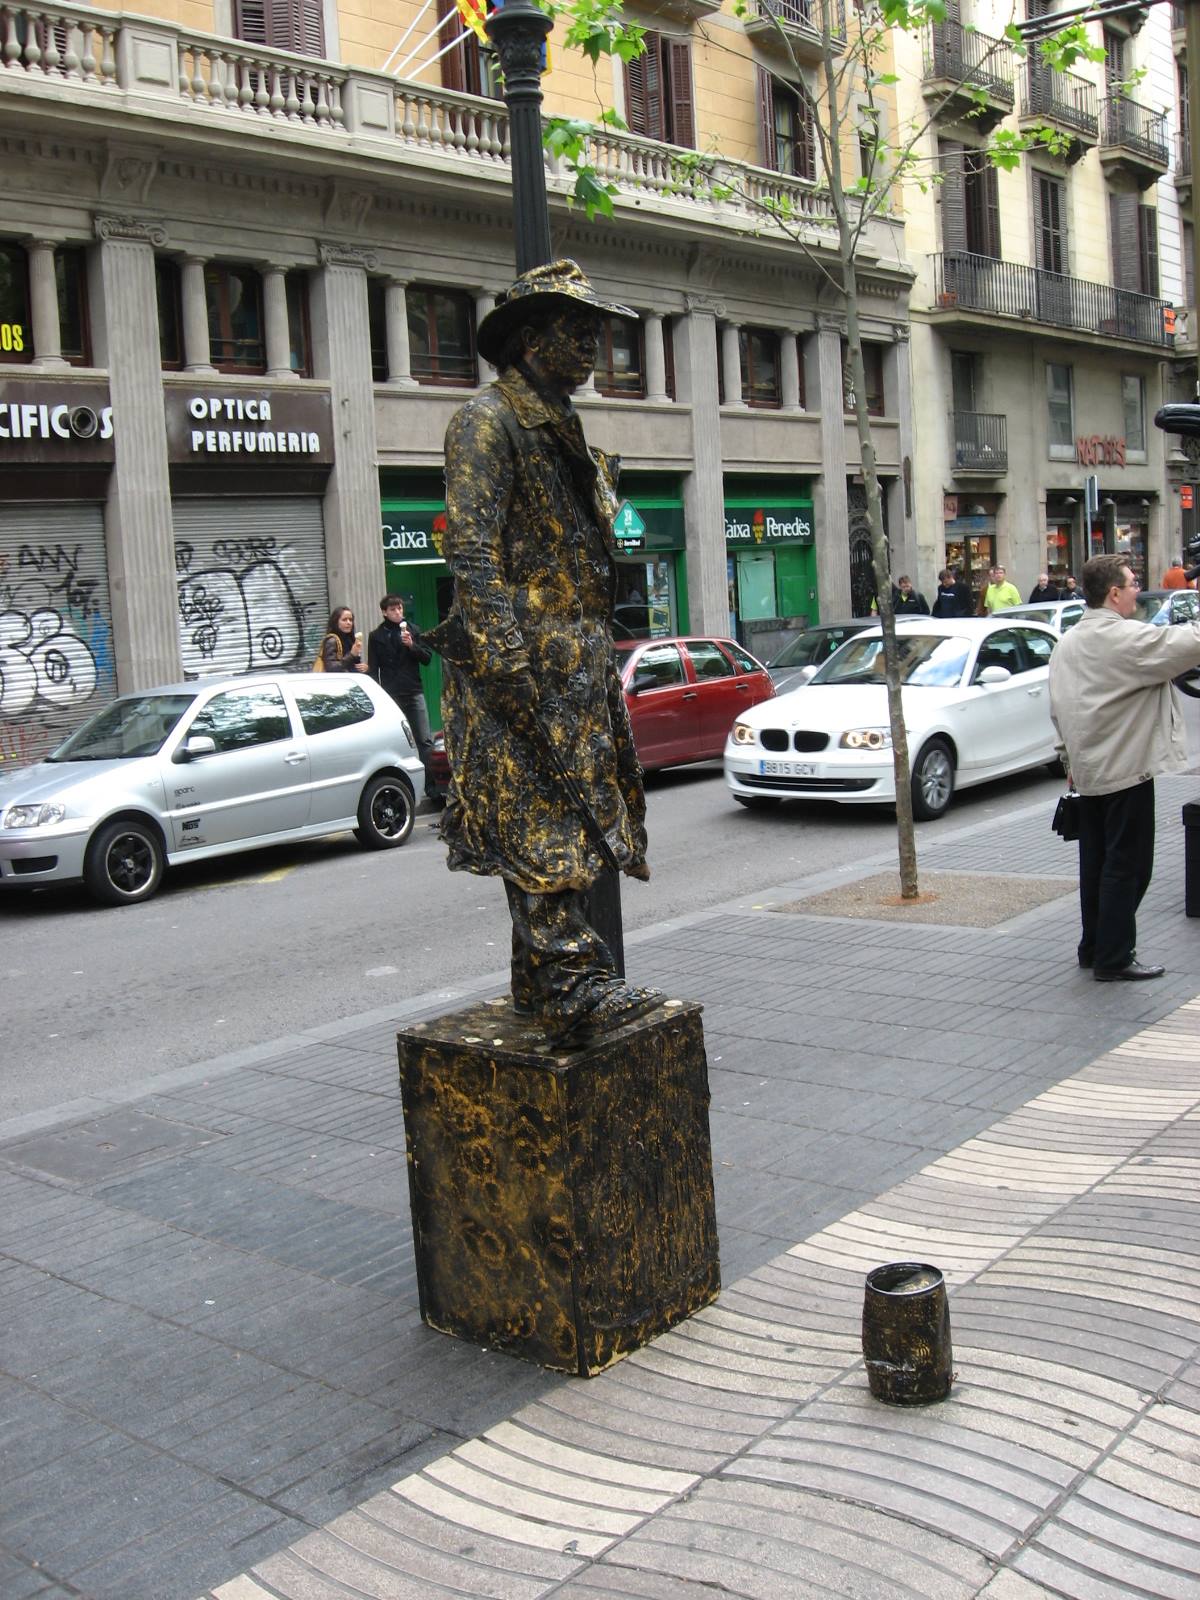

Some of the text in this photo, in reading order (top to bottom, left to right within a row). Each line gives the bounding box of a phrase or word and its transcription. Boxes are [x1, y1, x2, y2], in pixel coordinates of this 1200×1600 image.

[0, 324, 24, 351] OS
[190, 397, 272, 420] OPTICA
[191, 430, 320, 453] PERFUMERIA
[382, 525, 428, 550] Caixa
[725, 516, 810, 538] aixa Penedès
